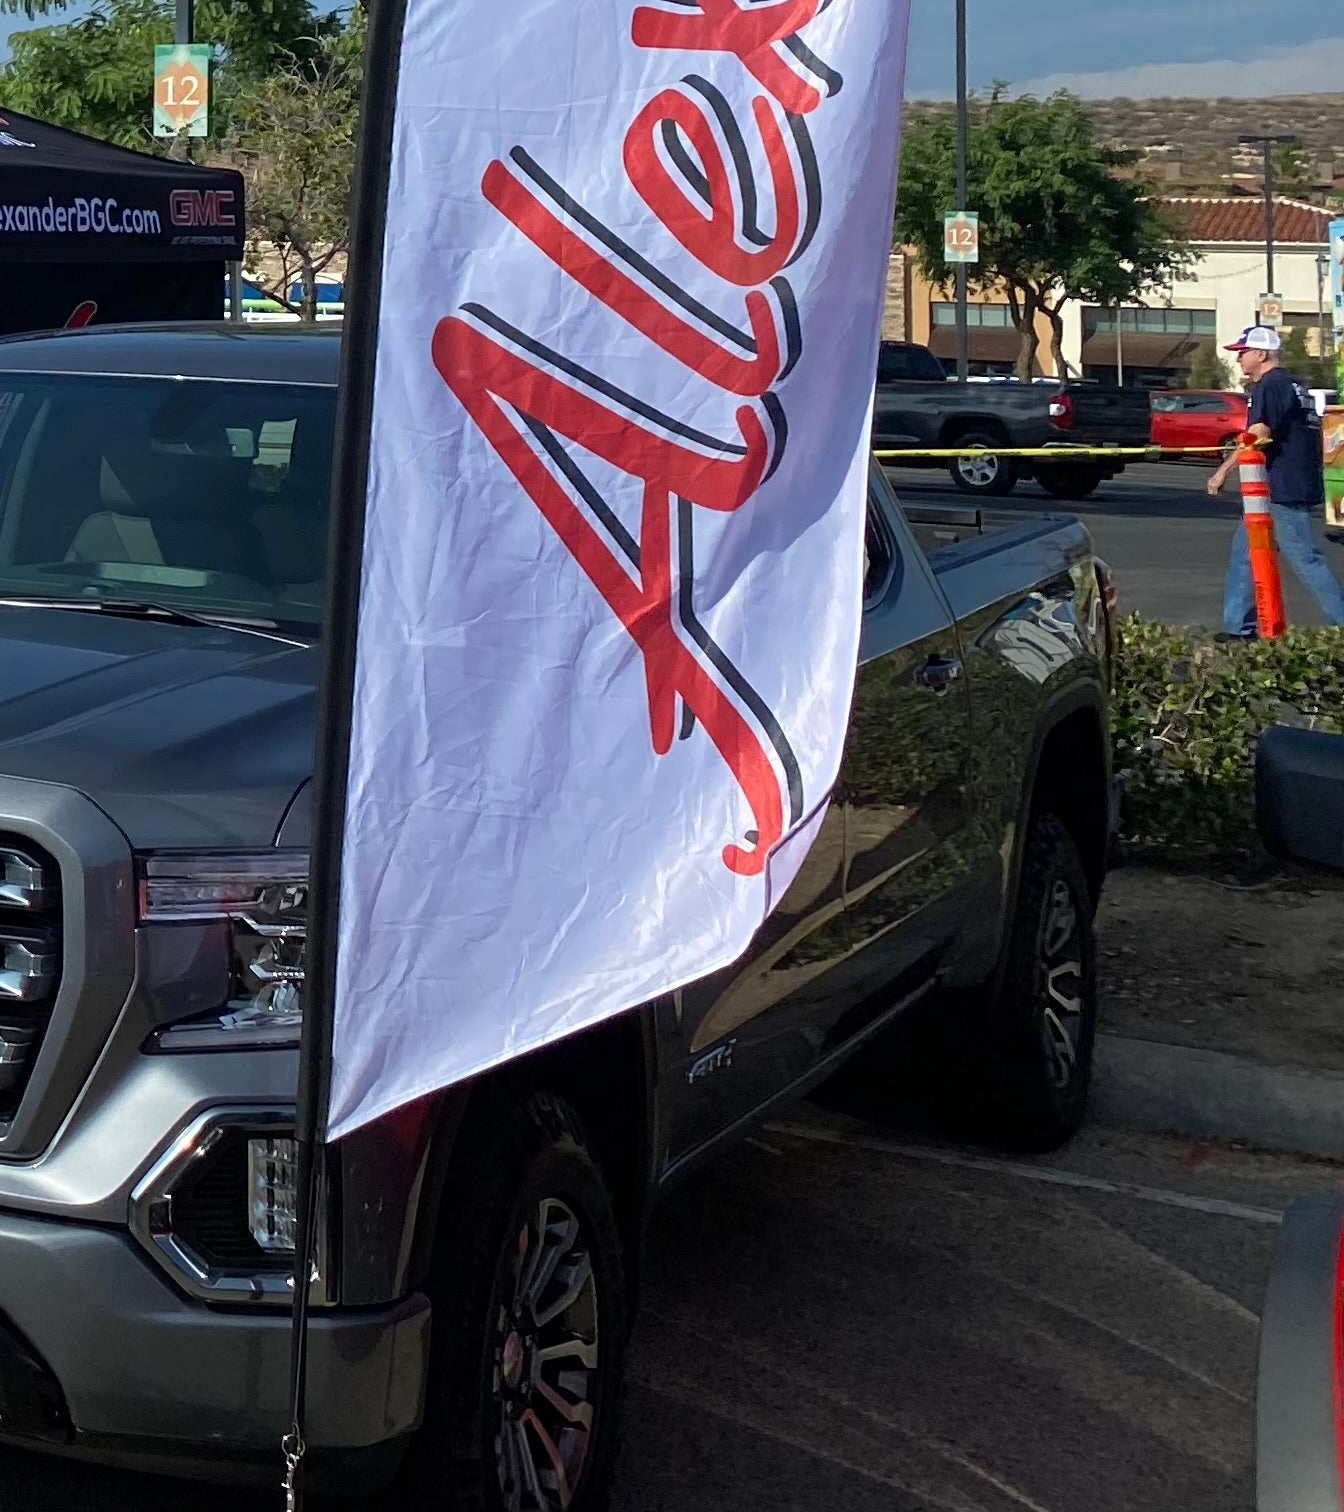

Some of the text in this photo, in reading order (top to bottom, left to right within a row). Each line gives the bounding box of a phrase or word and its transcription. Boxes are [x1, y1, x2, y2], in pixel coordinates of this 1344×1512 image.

[161, 76, 200, 106] 12
[169, 189, 236, 226] GMC
[948, 227, 974, 246] 12
